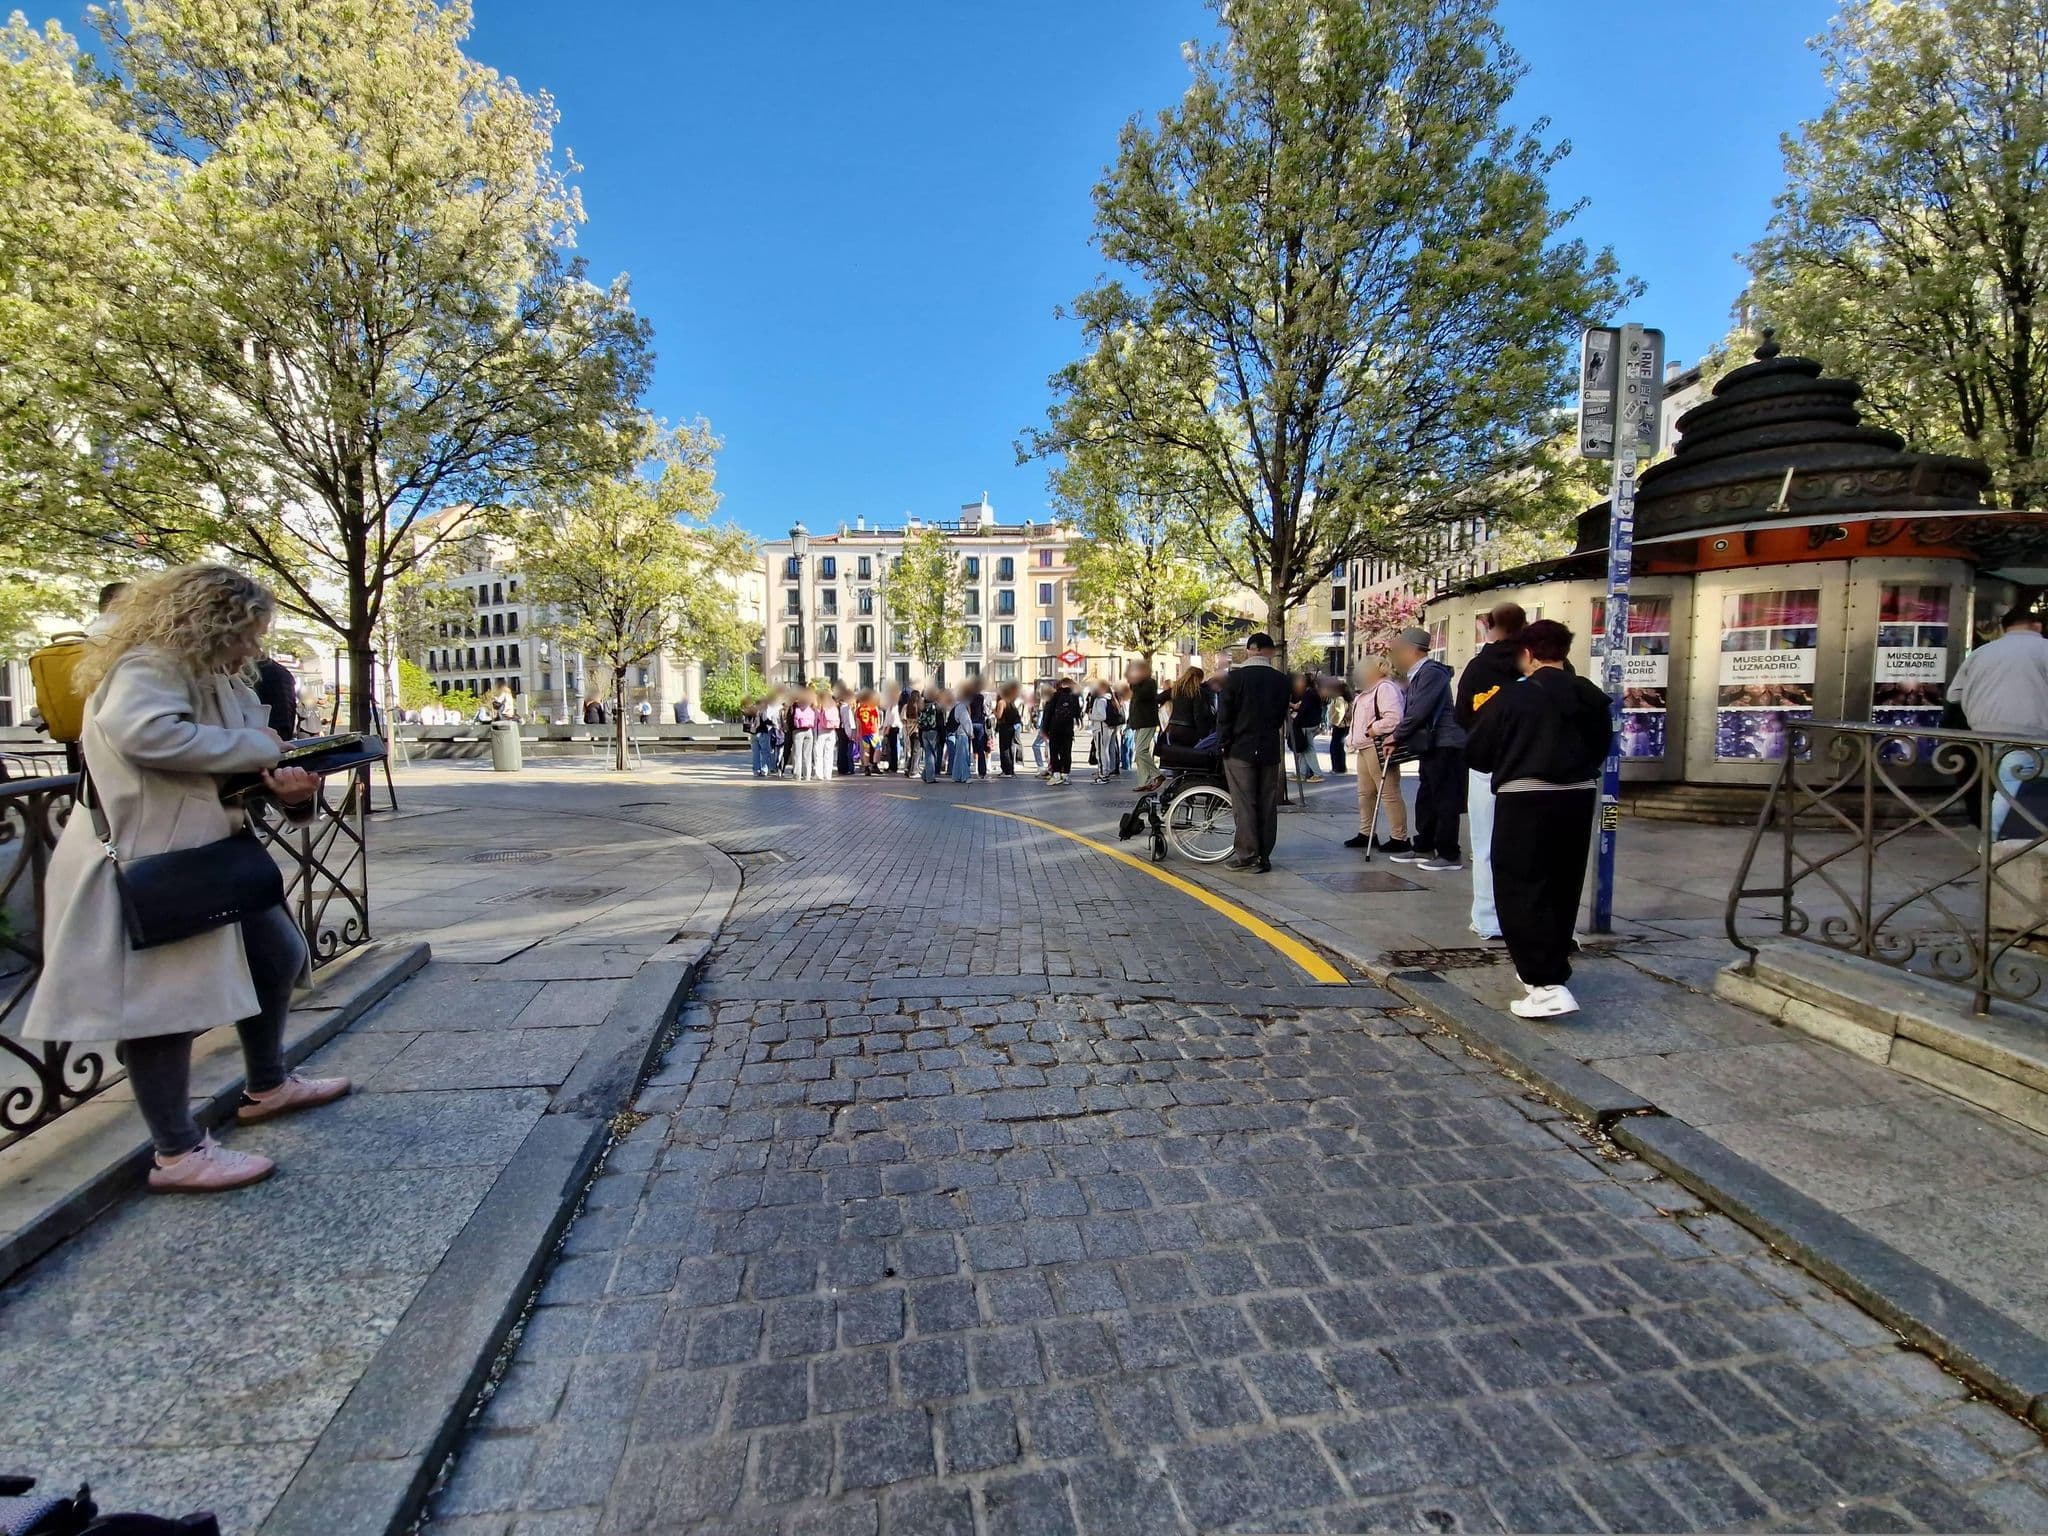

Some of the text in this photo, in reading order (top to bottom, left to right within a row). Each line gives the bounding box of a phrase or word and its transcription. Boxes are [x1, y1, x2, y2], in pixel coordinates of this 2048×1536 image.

[1733, 654, 1801, 664] MUSEODELA
[1887, 652, 1938, 660] MUSEODELA
[1732, 662, 1800, 671] LUZMADRID.
[1603, 806, 1618, 830] SAEM
